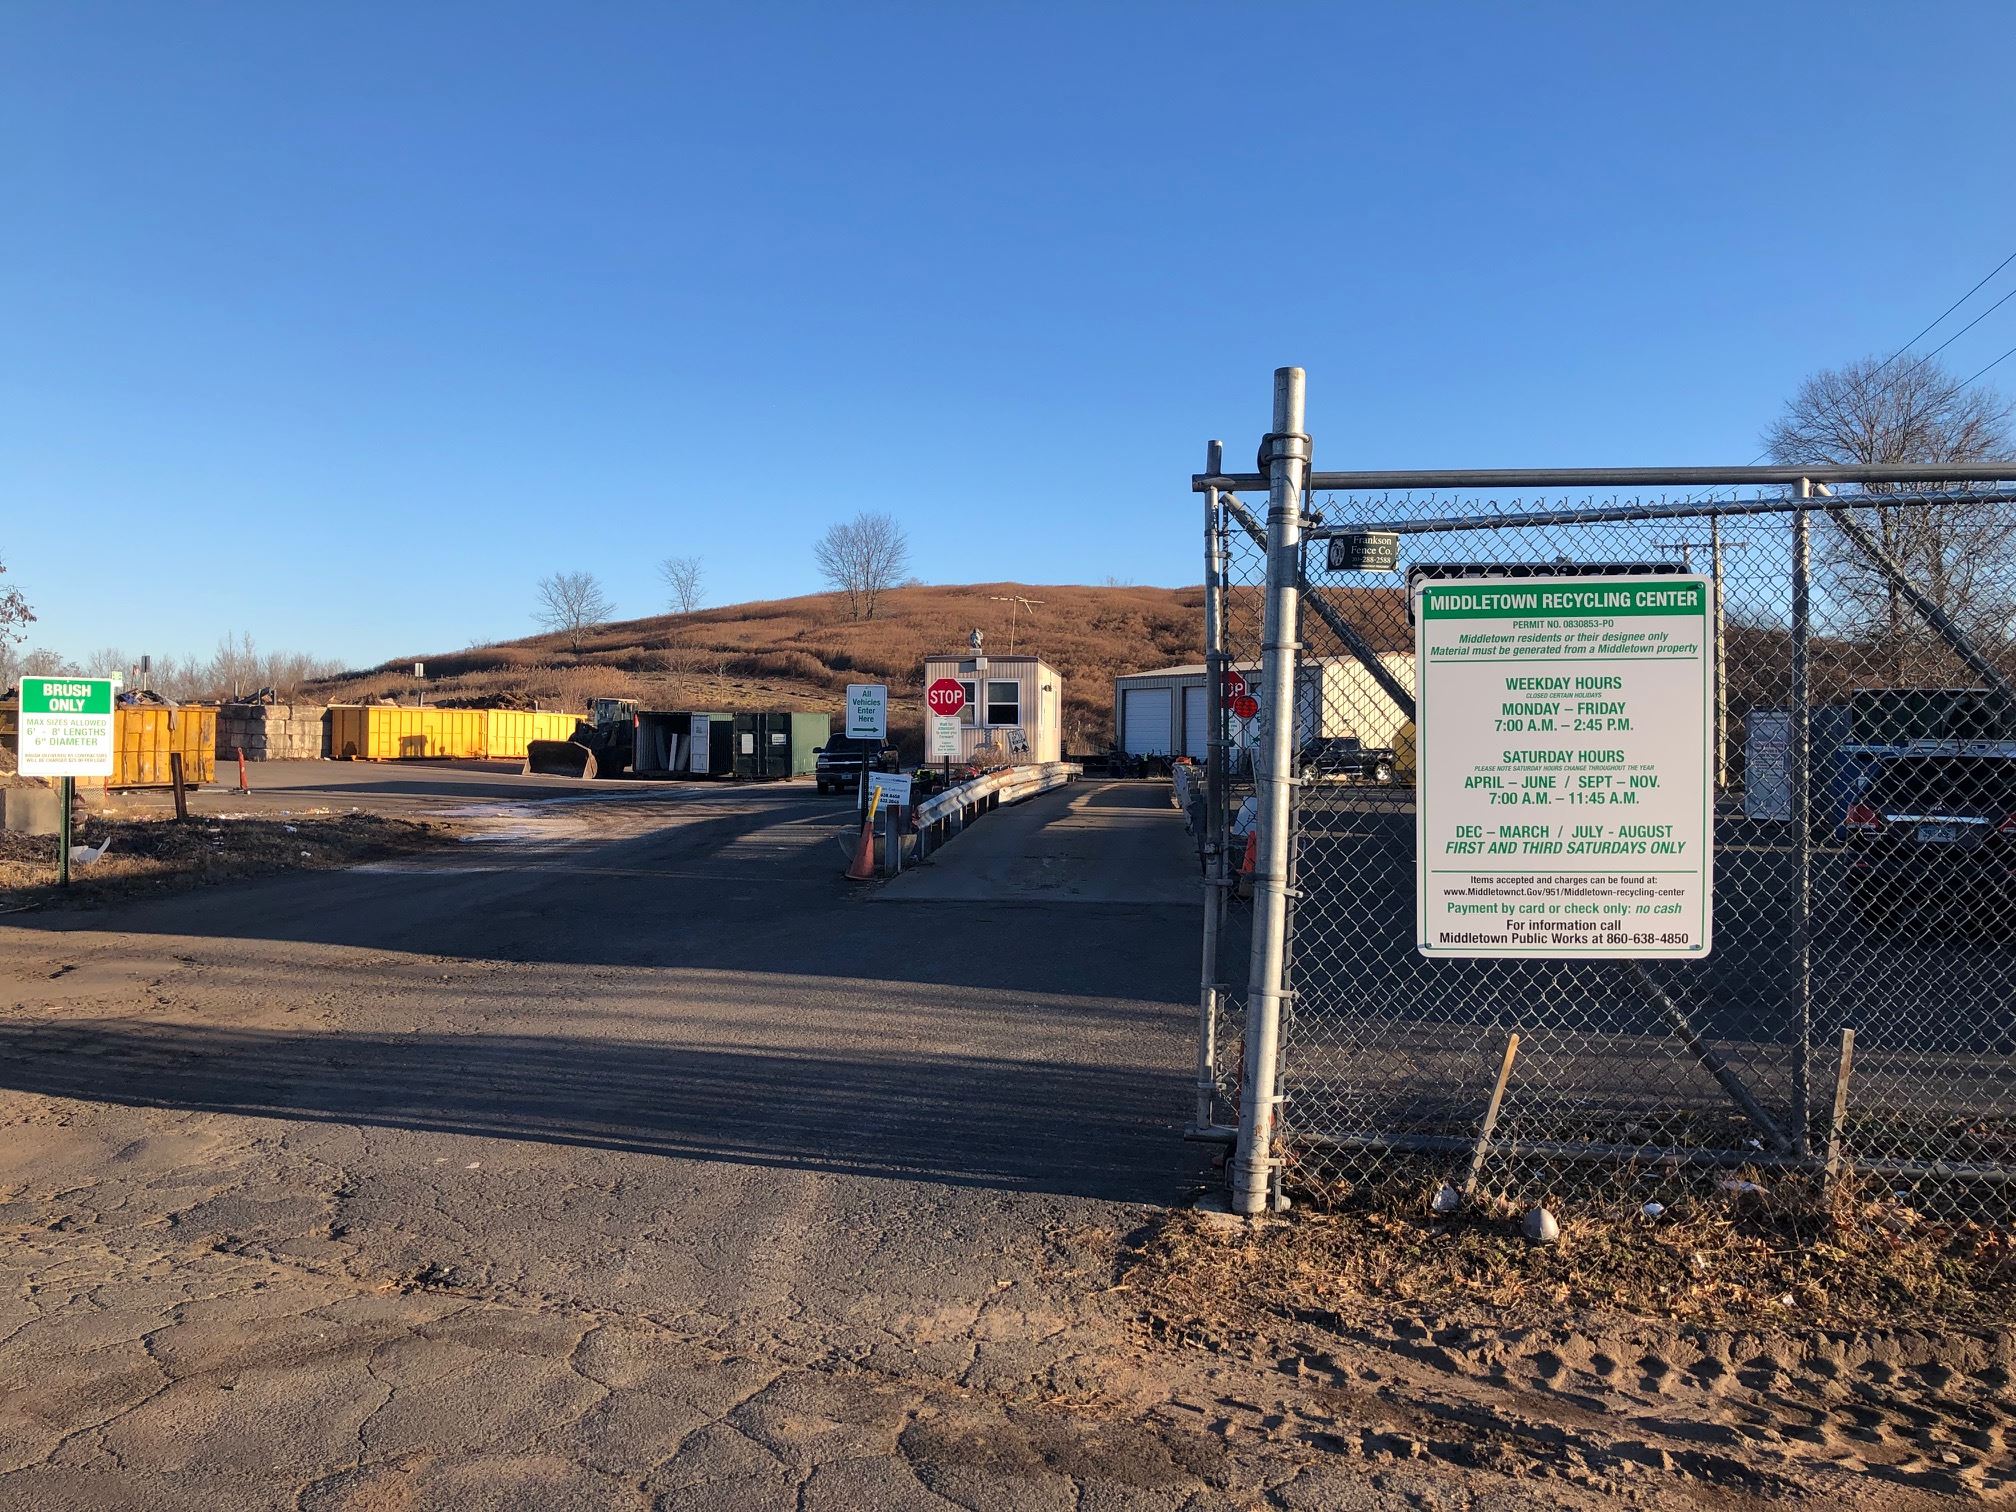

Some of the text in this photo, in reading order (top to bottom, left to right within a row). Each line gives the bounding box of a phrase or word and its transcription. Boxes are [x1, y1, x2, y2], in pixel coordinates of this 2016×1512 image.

[1353, 536, 1392, 545] Frankson
[1351, 546, 1392, 555] Fence Co.
[1429, 591, 1697, 610] MIDDLETOWN RECYCLING CENTER
[1459, 635, 1514, 643] Middletown
[1518, 633, 1562, 642] residents
[1578, 633, 1599, 641] their
[1602, 632, 1645, 643] designee
[1648, 632, 1668, 642] only
[1431, 647, 1470, 655] Material
[1472, 646, 1496, 654] must
[1497, 646, 1510, 654] be
[1513, 645, 1561, 656] generated
[1564, 645, 1586, 653] from
[1598, 644, 1654, 653] Middletown
[1657, 644, 1698, 654] property
[1506, 677, 1621, 690] WEEKDAY HOURS
[43, 683, 91, 697] BRUSH
[852, 698, 881, 706] Vehicles
[930, 690, 962, 704] STOP
[49, 698, 86, 711] ONLY
[1503, 703, 1560, 715] MONDAY
[1578, 702, 1625, 714] FRIDAY
[1495, 719, 1523, 731] 7:00
[1528, 719, 1557, 731] A.M.
[1574, 719, 1602, 731] 2:45
[1608, 719, 1633, 730] P.M.
[63, 728, 106, 736] LENGTHS
[1503, 750, 1624, 763] SATURDAY HOURS
[1465, 776, 1504, 788] APRIL
[1522, 776, 1556, 788] JUNE
[1579, 776, 1612, 788] SEPT
[1630, 776, 1659, 787] NOV.
[1489, 793, 1517, 804] 7:00
[1522, 792, 1551, 804] A.M.
[1569, 792, 1605, 804] 11:45
[1610, 792, 1639, 804] A.M.
[1457, 826, 1482, 838] DEC
[1500, 826, 1549, 838] MARCH
[1572, 826, 1603, 838] JULY
[1619, 826, 1673, 838] AUGUST
[1446, 842, 1686, 854] FIRST AND THIRD SATURDAYS ONLY
[1497, 876, 1534, 885] accepted
[1555, 876, 1587, 885] charges
[1444, 888, 1684, 897] www.Middletownct.Gov/951/Middletown-recycling-center
[1448, 902, 1498, 915] Payment
[1502, 903, 1515, 915] by
[1519, 903, 1544, 913] card
[1549, 905, 1560, 913] or
[1565, 903, 1599, 913] check
[1603, 903, 1630, 916] only:
[1654, 903, 1681, 913] cash
[1507, 920, 1620, 930] For information call
[1440, 933, 1688, 944] Middletown Public Works at 860-638-4850
